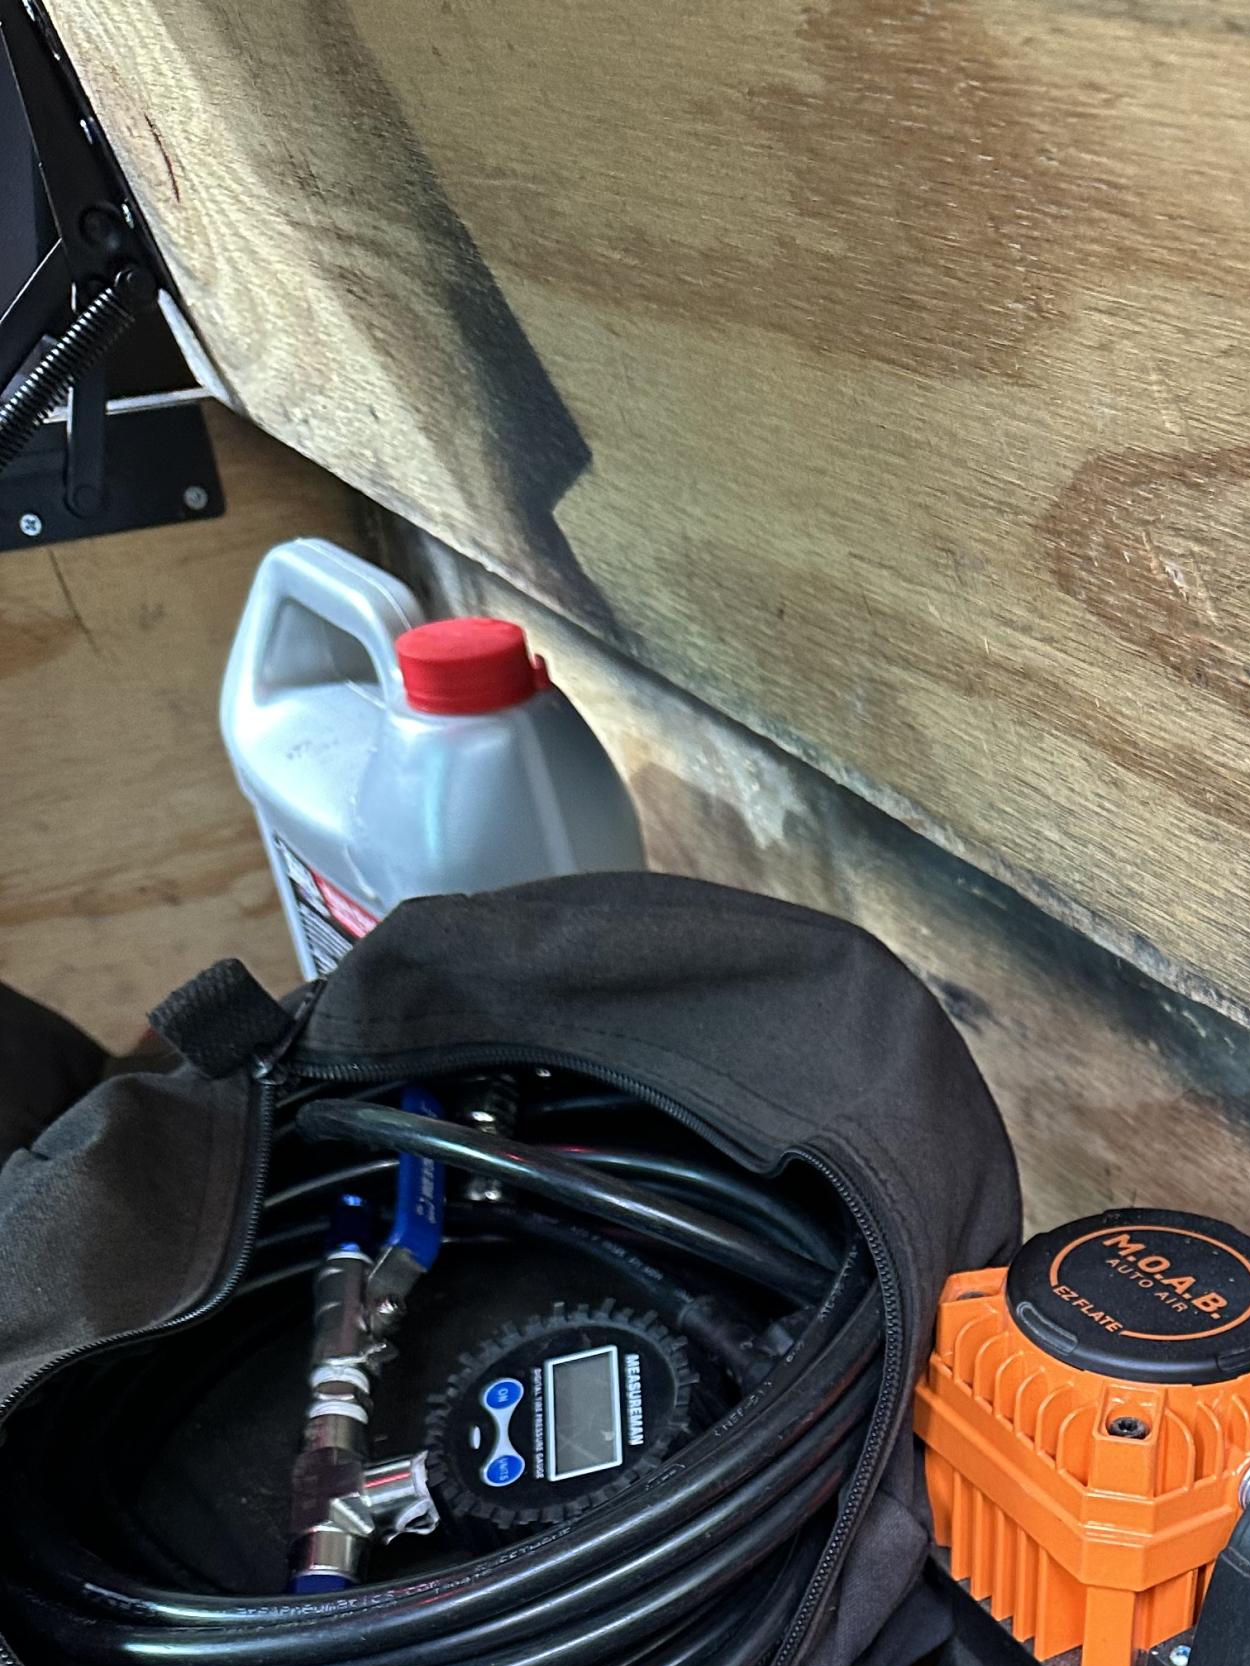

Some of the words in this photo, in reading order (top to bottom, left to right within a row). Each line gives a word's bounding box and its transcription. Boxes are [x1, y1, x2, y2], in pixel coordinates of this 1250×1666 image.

[1102, 1233, 1229, 1320] M.O.A.B.
[1106, 1258, 1153, 1289] AUTO
[1155, 1290, 1189, 1313] AIR
[1053, 1284, 1078, 1303] EZ
[1075, 1298, 1123, 1333] FLATE
[497, 1388, 509, 1403] ON
[625, 1353, 645, 1446] MEASUREMAN
[498, 1457, 510, 1481] UNITS
